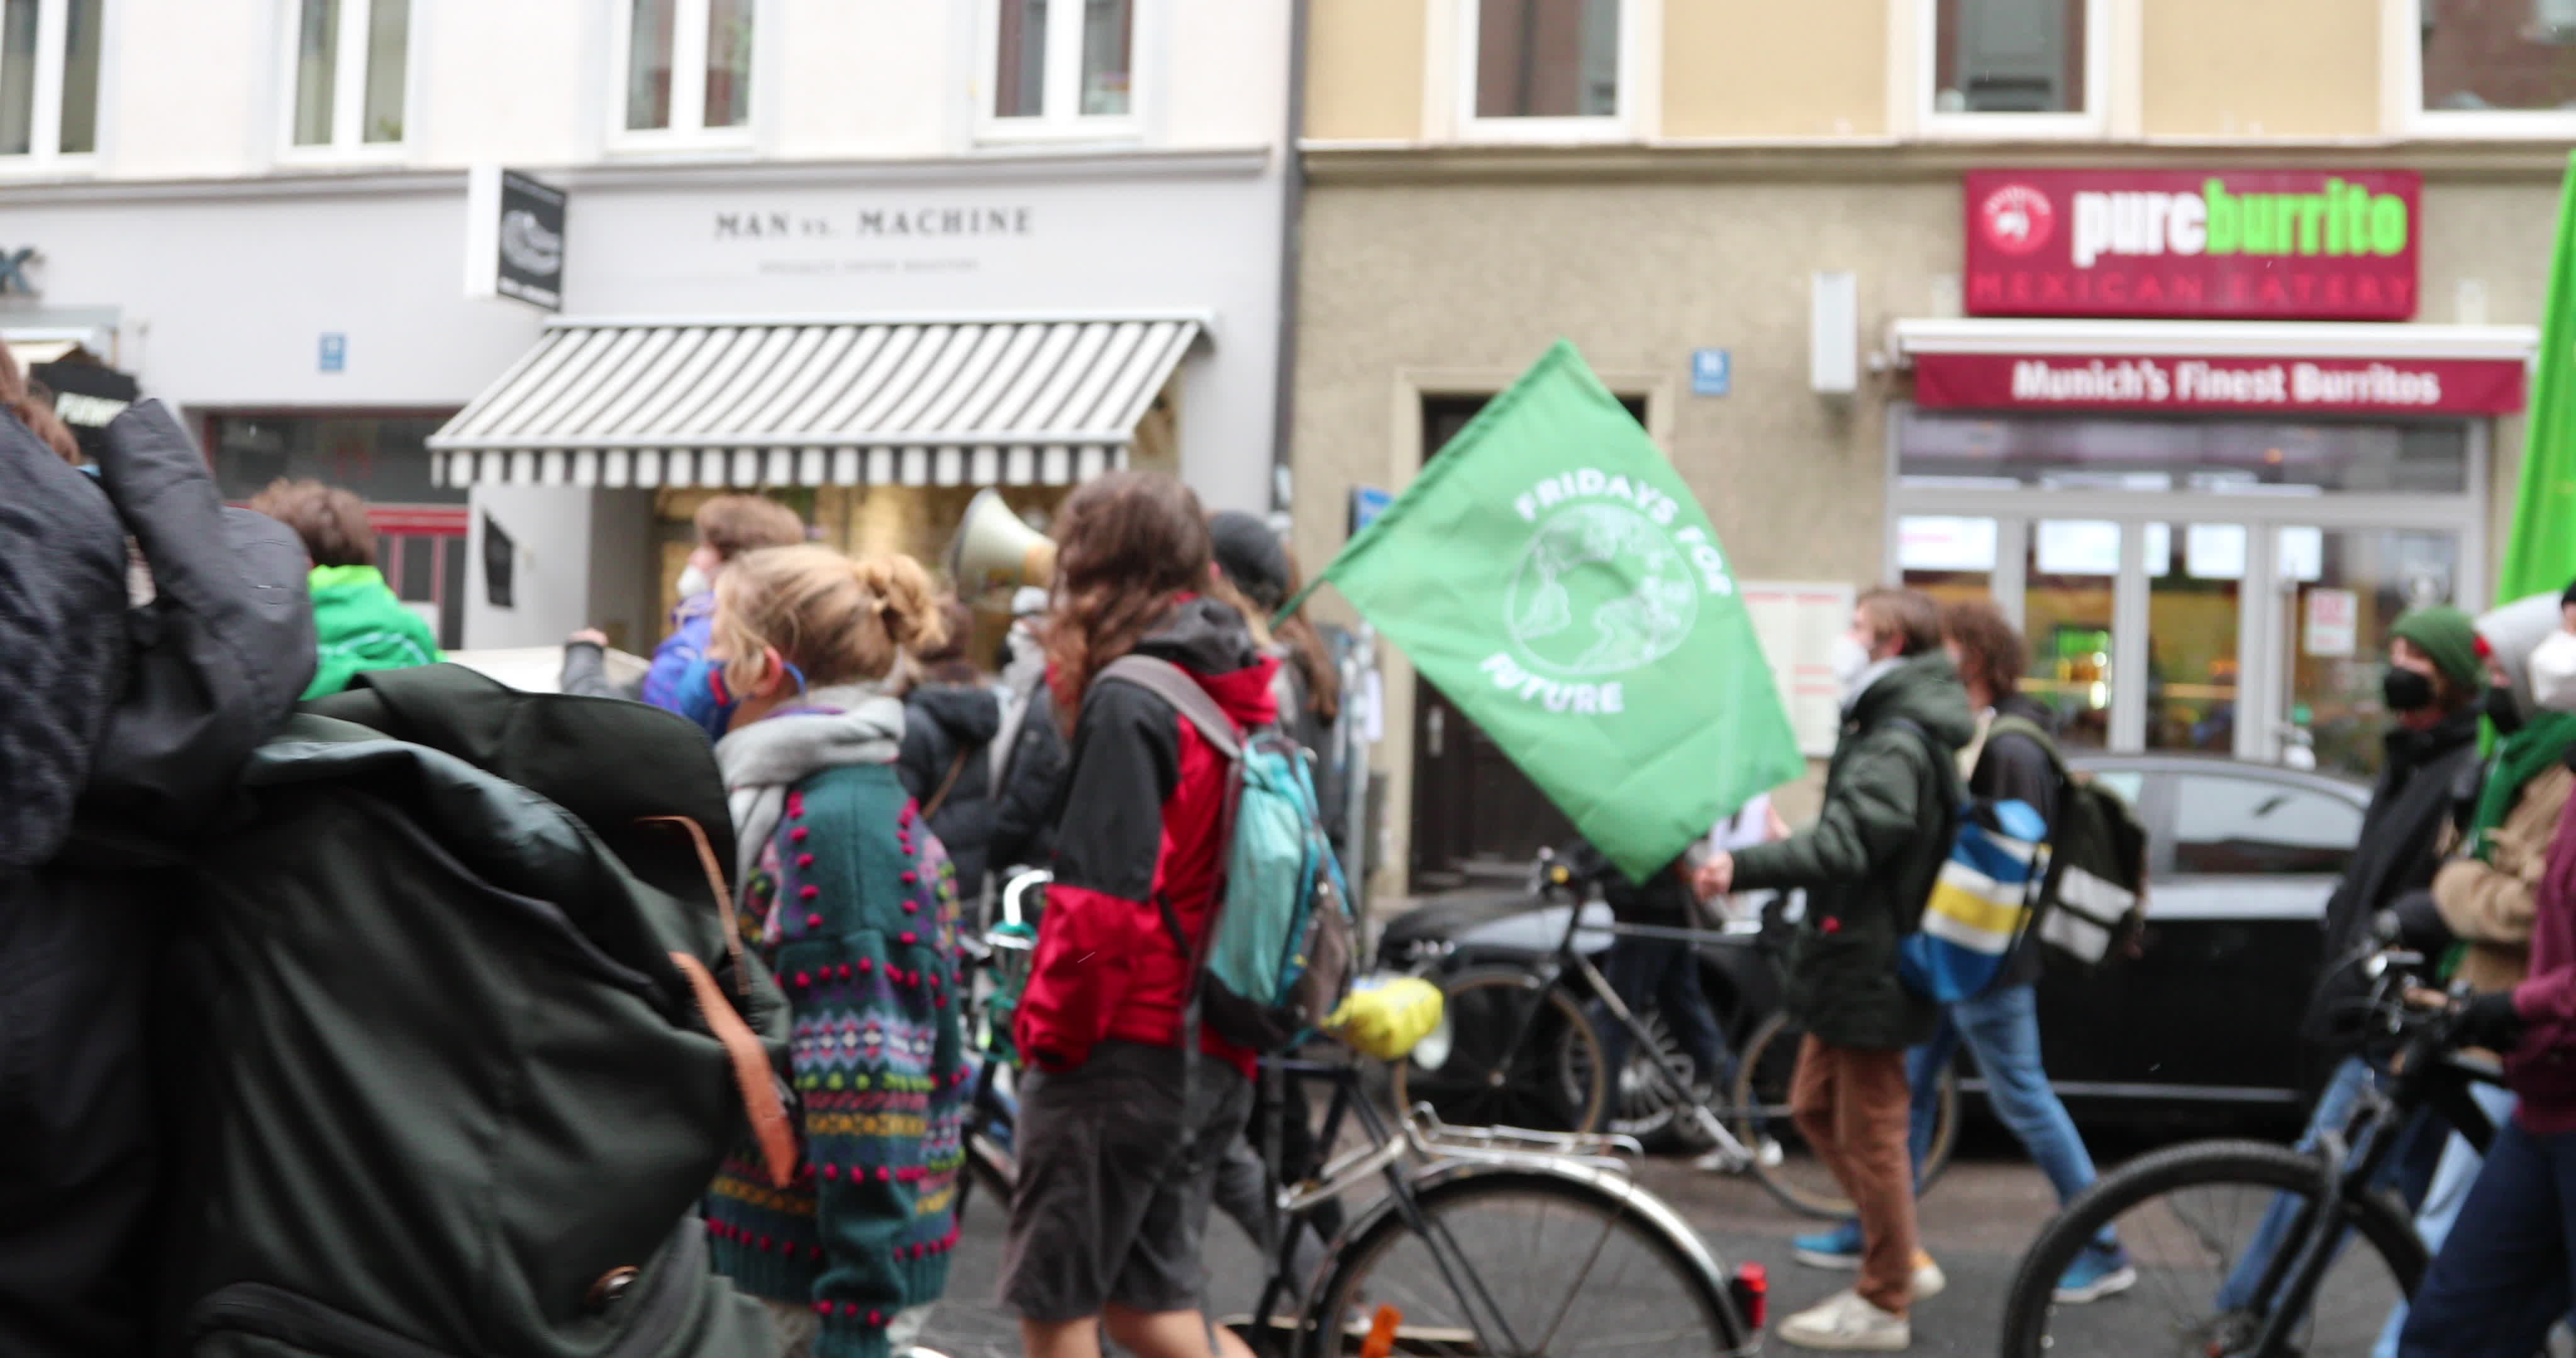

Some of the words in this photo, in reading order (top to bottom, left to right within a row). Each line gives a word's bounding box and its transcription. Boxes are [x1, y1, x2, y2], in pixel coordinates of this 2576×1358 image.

[716, 213, 789, 238] MAN
[858, 207, 1031, 235] MACHINE
[1974, 275, 2202, 301] MEXICAN
[2233, 276, 2409, 301] EATERY
[2014, 362, 2168, 399] Munich's
[2176, 363, 2285, 401] Finest
[2292, 364, 2440, 404] Burritos
[1516, 468, 1678, 524] FRIDAYS
[1677, 526, 1731, 595] FOR
[1480, 653, 1623, 714] FUTURE
